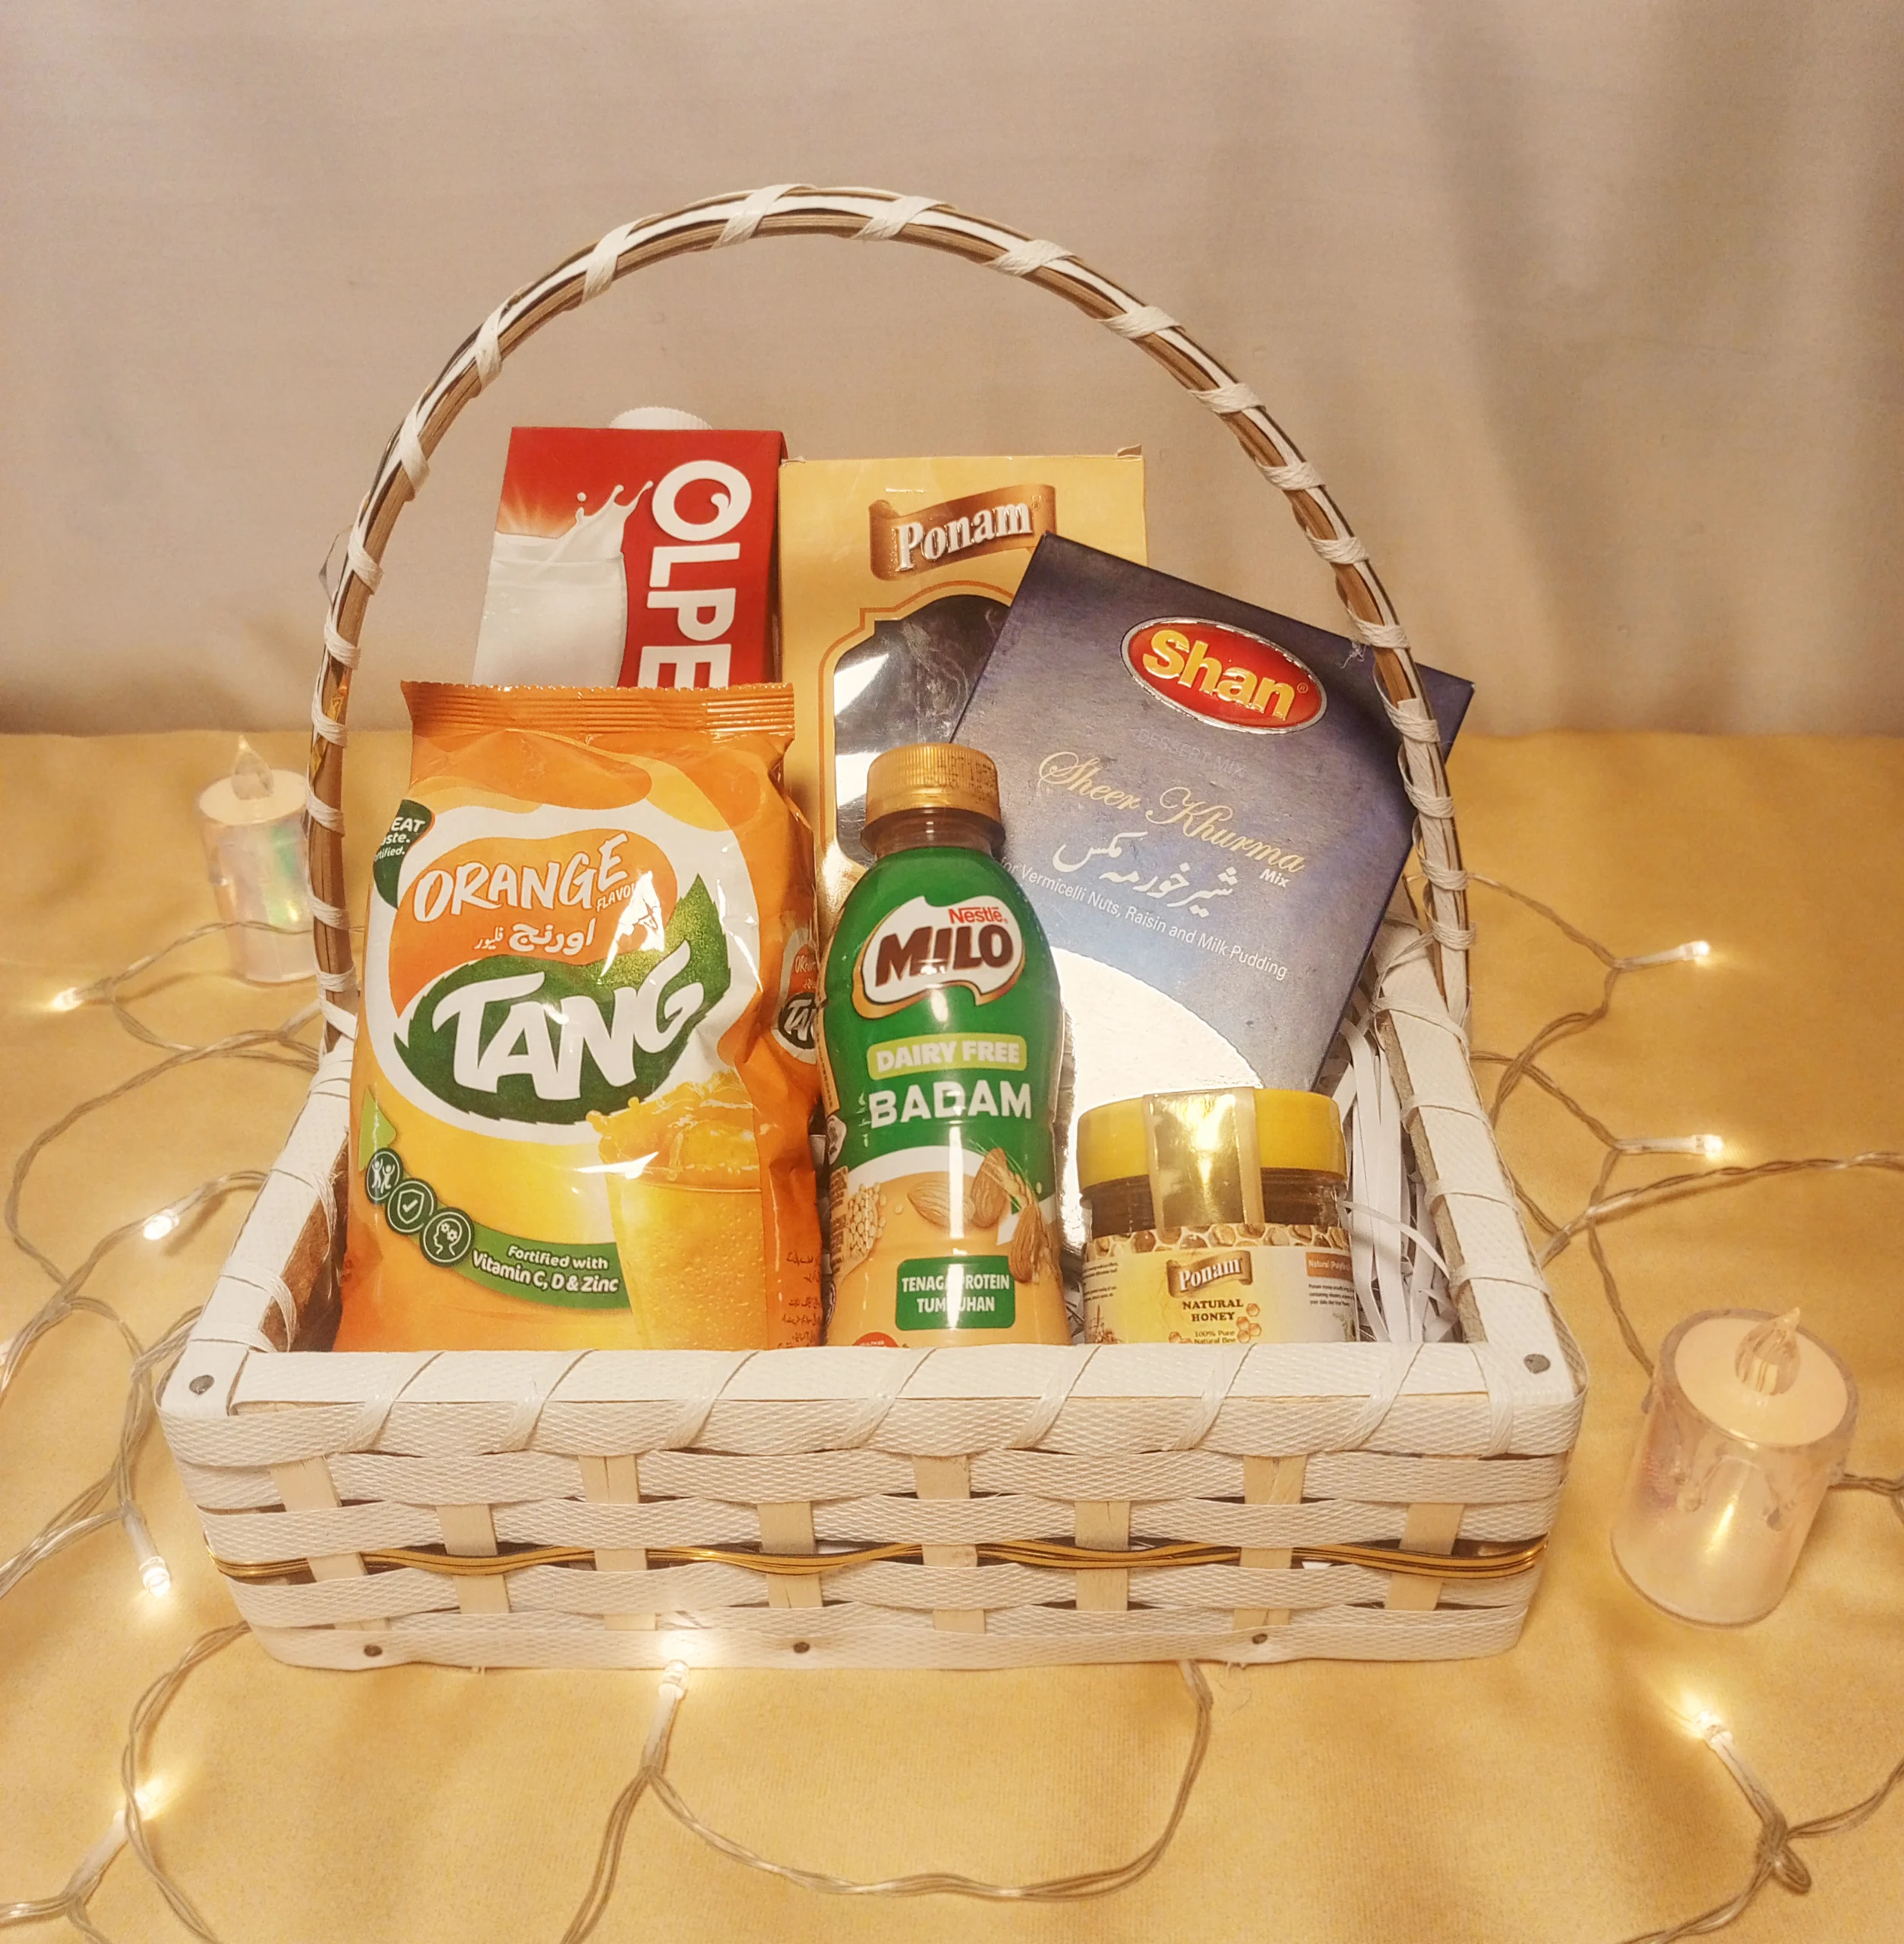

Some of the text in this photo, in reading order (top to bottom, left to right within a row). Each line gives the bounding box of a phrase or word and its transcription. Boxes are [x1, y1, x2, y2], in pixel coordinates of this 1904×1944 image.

[895, 501, 1034, 572] Ponam
[1142, 629, 1296, 721] Shan
[391, 816, 426, 832] EAT
[1037, 751, 1140, 810] Sheer
[1145, 786, 1305, 873] Khurma
[413, 832, 636, 923] ORANGE FLAVO
[1260, 868, 1289, 888] Mix
[509, 917, 596, 956] اورنج
[1000, 856, 1288, 981] for Vermicelli Nuts, Raisin and Milk Pudding
[875, 925, 1015, 987] MILO
[431, 939, 705, 1101] TANG
[876, 1040, 1019, 1072] DAIRY FREE
[869, 1080, 1032, 1129] BADAM
[472, 1250, 619, 1292] Vitamin C, D & Zinc
[508, 1245, 608, 1270] Fortified with
[1179, 1258, 1241, 1291] Ponam
[901, 1274, 1009, 1292] TENAG ROTEIN
[917, 1296, 995, 1314] TUMUHAN
[1183, 1299, 1243, 1310] NATURAL
[1191, 1312, 1235, 1322] HONEY
